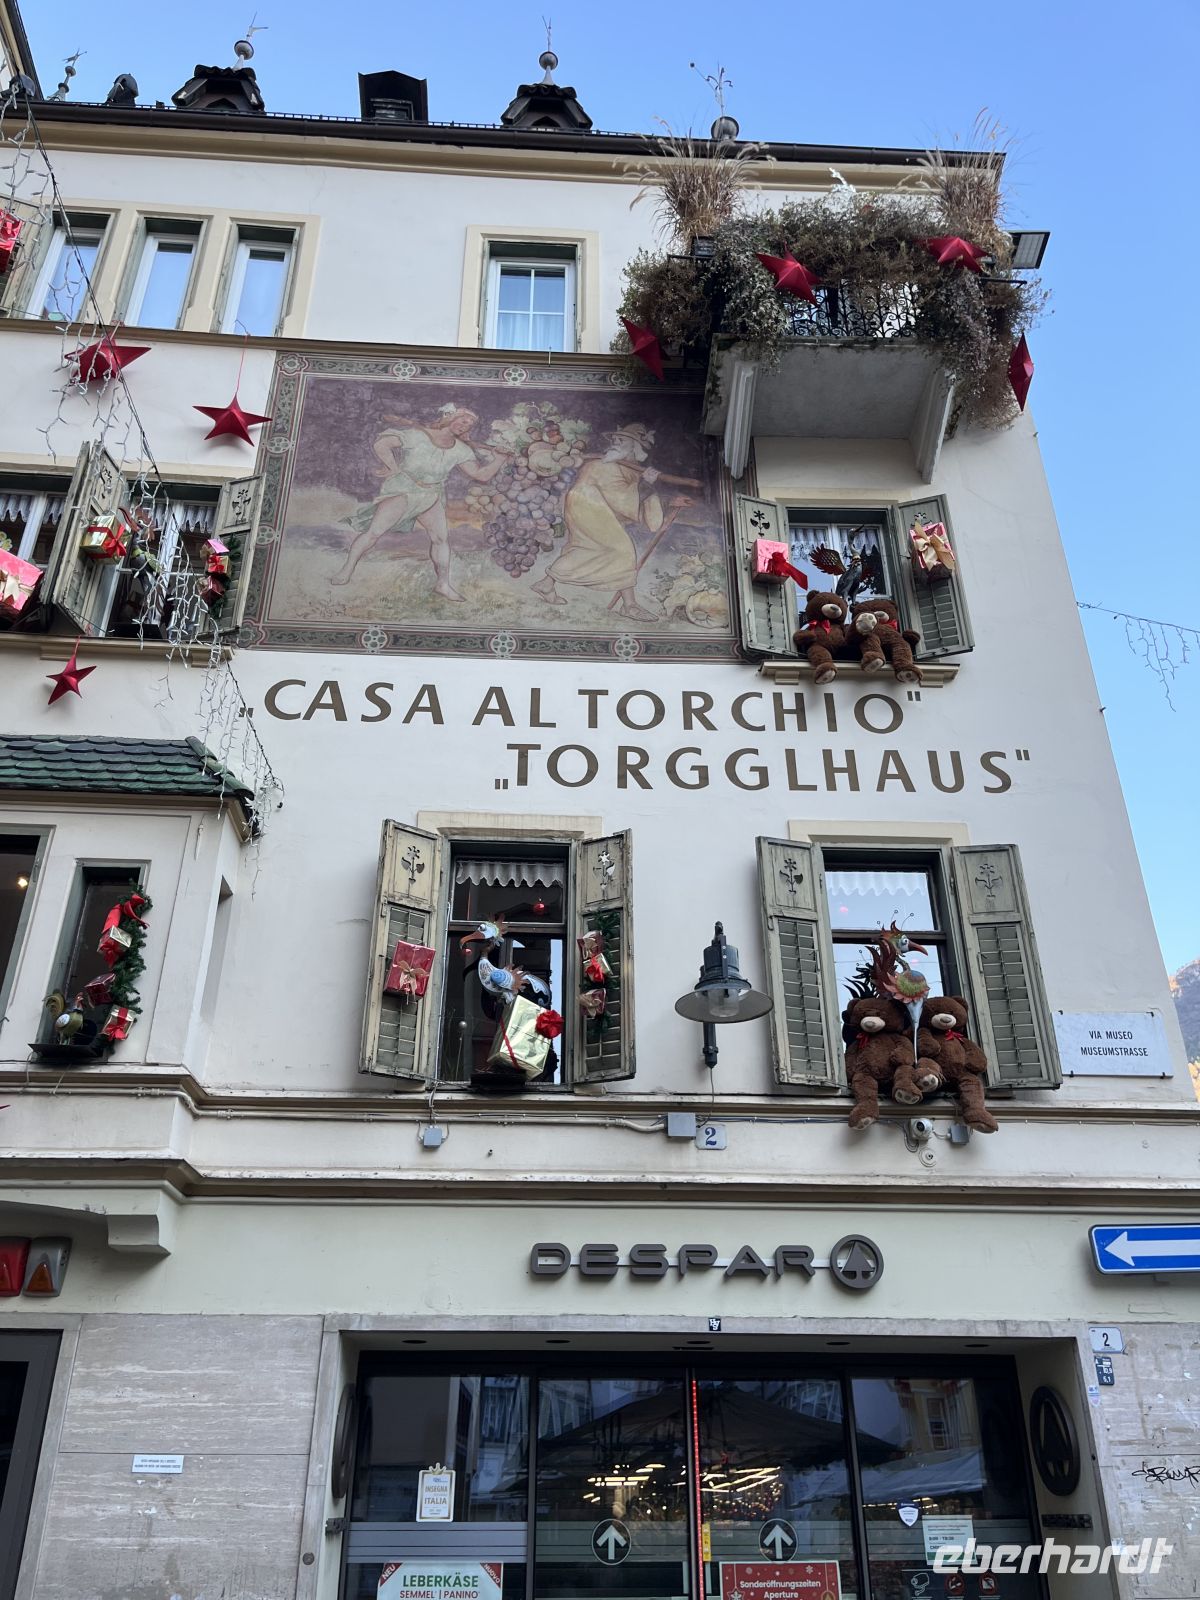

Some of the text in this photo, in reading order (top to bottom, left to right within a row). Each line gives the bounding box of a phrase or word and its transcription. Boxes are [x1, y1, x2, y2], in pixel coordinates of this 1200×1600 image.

[471, 686, 557, 729] AL
[1088, 1030, 1133, 1040] VIA MUSEO
[1080, 1046, 1149, 1057] MUSEUMSTRASSE
[704, 1126, 717, 1146] 2
[530, 1242, 816, 1280] DESPAR
[1102, 1332, 1110, 1347] 2
[425, 1484, 448, 1493] INSEGNA
[424, 1497, 447, 1505] ITALIA
[381, 1563, 396, 1580] NEU
[483, 1564, 501, 1584] NUOVO
[403, 1572, 479, 1588] LEBERKÄSE
[739, 1580, 822, 1590] Sonderöffnungszeiten
[763, 1591, 799, 1600] Aperture
